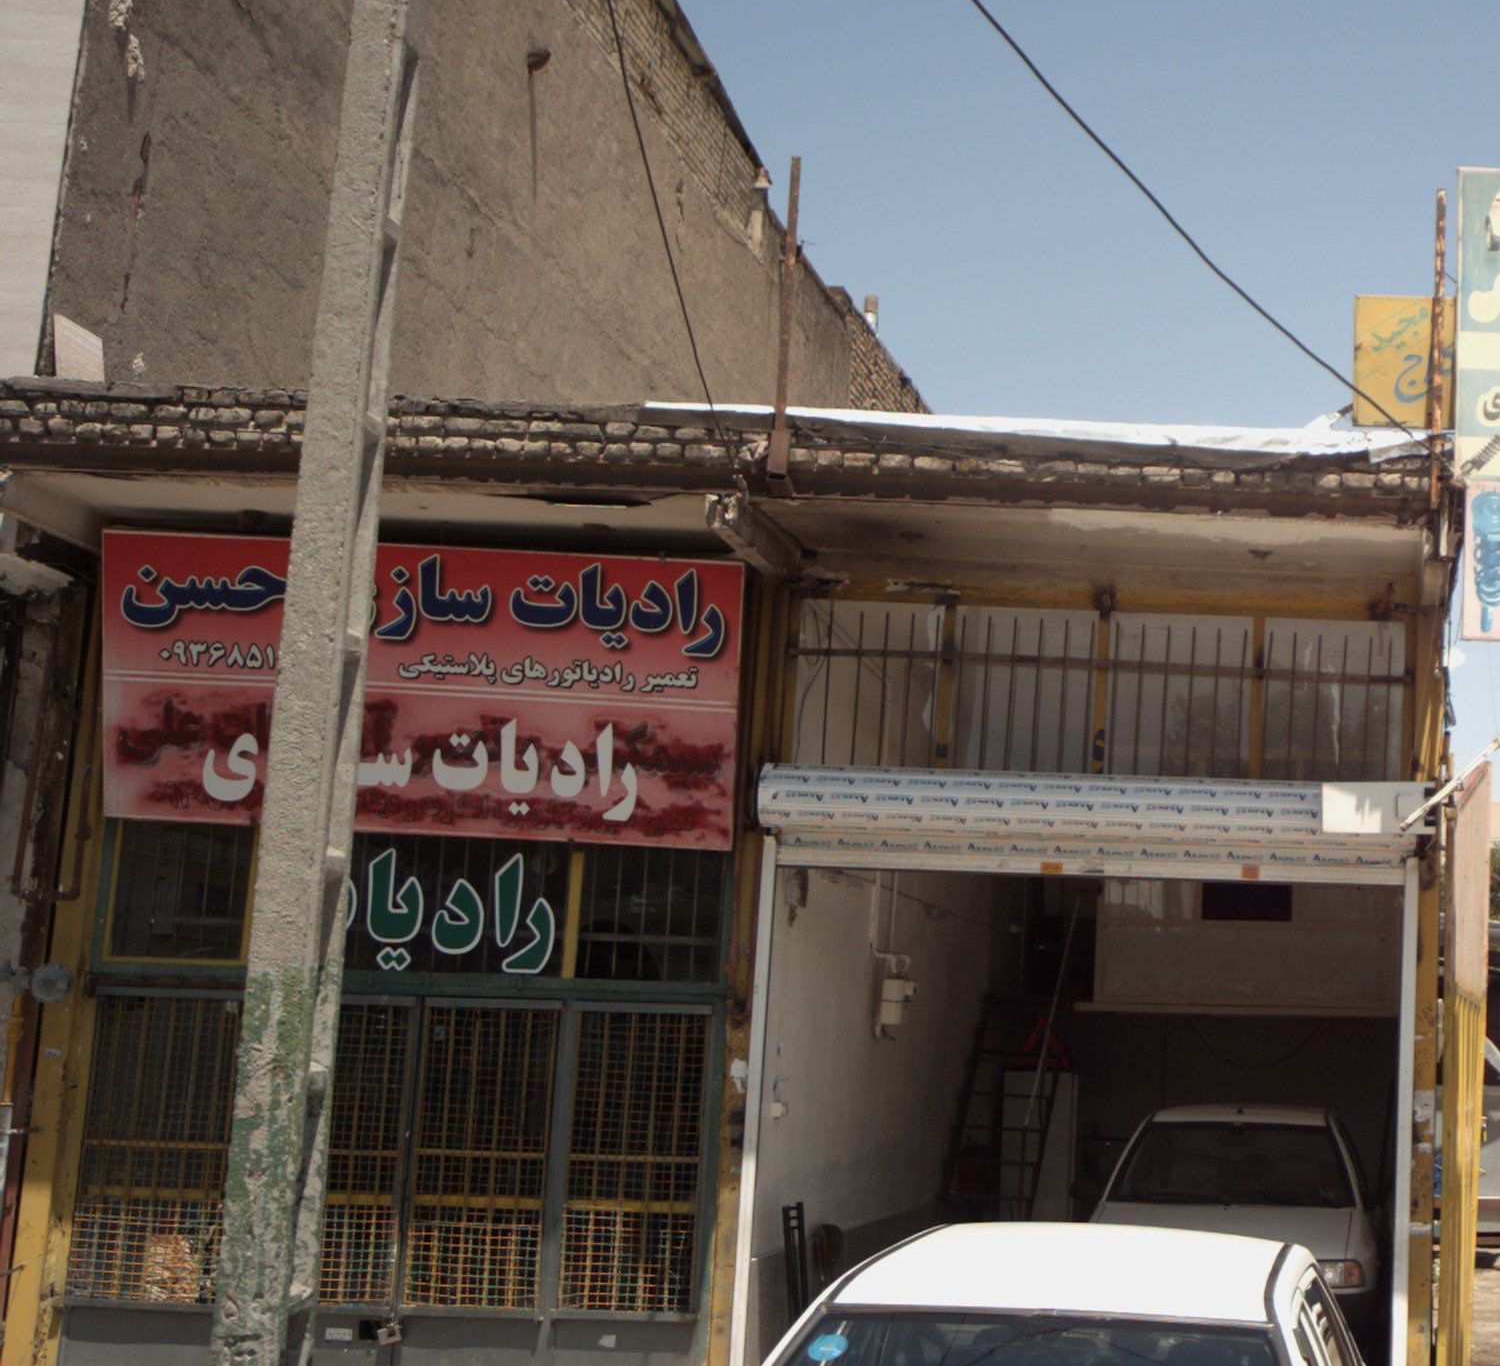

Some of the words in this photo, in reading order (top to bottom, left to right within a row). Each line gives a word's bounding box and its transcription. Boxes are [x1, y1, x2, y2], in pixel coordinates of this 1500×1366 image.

[369, 553, 492, 640] ساز
[511, 561, 727, 659] رادیات
[398, 652, 496, 684] پلاستیکی
[639, 666, 698, 695] تعمیر
[433, 718, 638, 823] رادیات
[346, 848, 556, 975] رادیا
